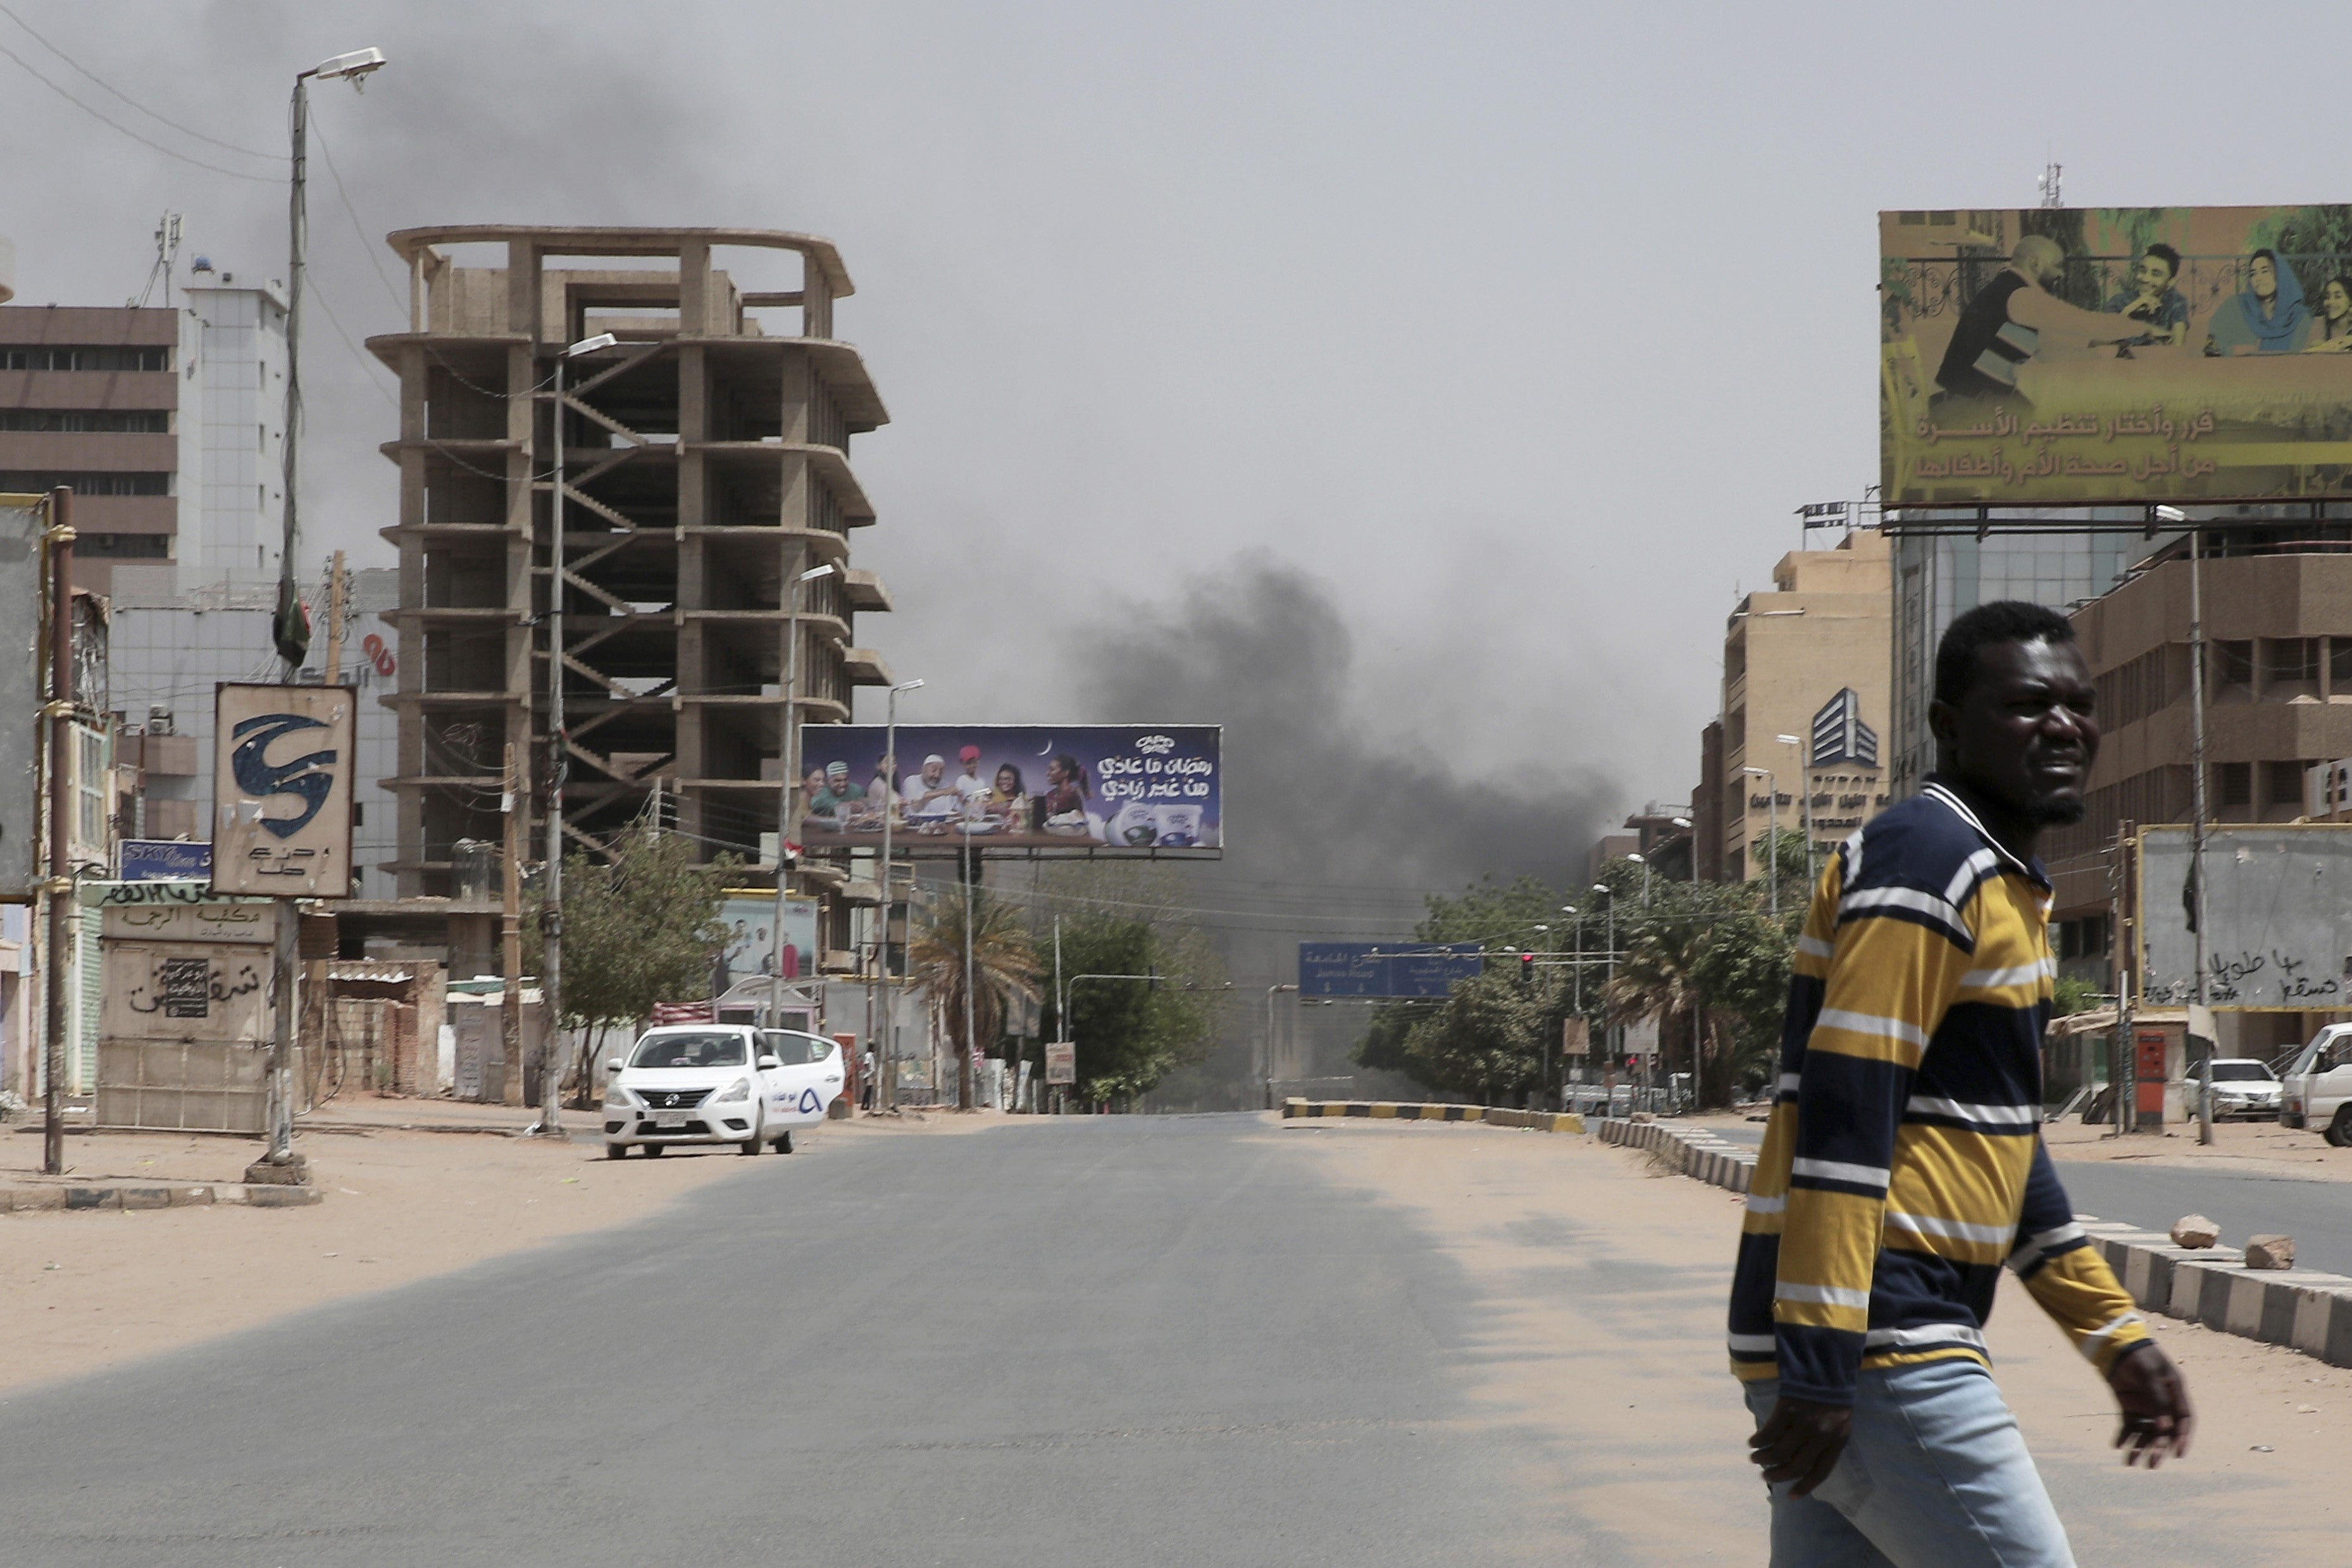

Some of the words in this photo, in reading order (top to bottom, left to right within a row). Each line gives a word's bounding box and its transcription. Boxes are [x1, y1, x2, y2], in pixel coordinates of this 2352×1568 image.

[2024, 413, 2098, 446] تنظيم
[2179, 407, 2214, 441] قرر
[1915, 445, 2015, 486] وأطفالها
[2018, 444, 2062, 485] الأم
[2065, 454, 2128, 476] صحة
[2131, 444, 2177, 482] أجل
[2180, 457, 2214, 480] من
[121, 905, 180, 930] الرحمة
[196, 904, 261, 928] مكتبة
